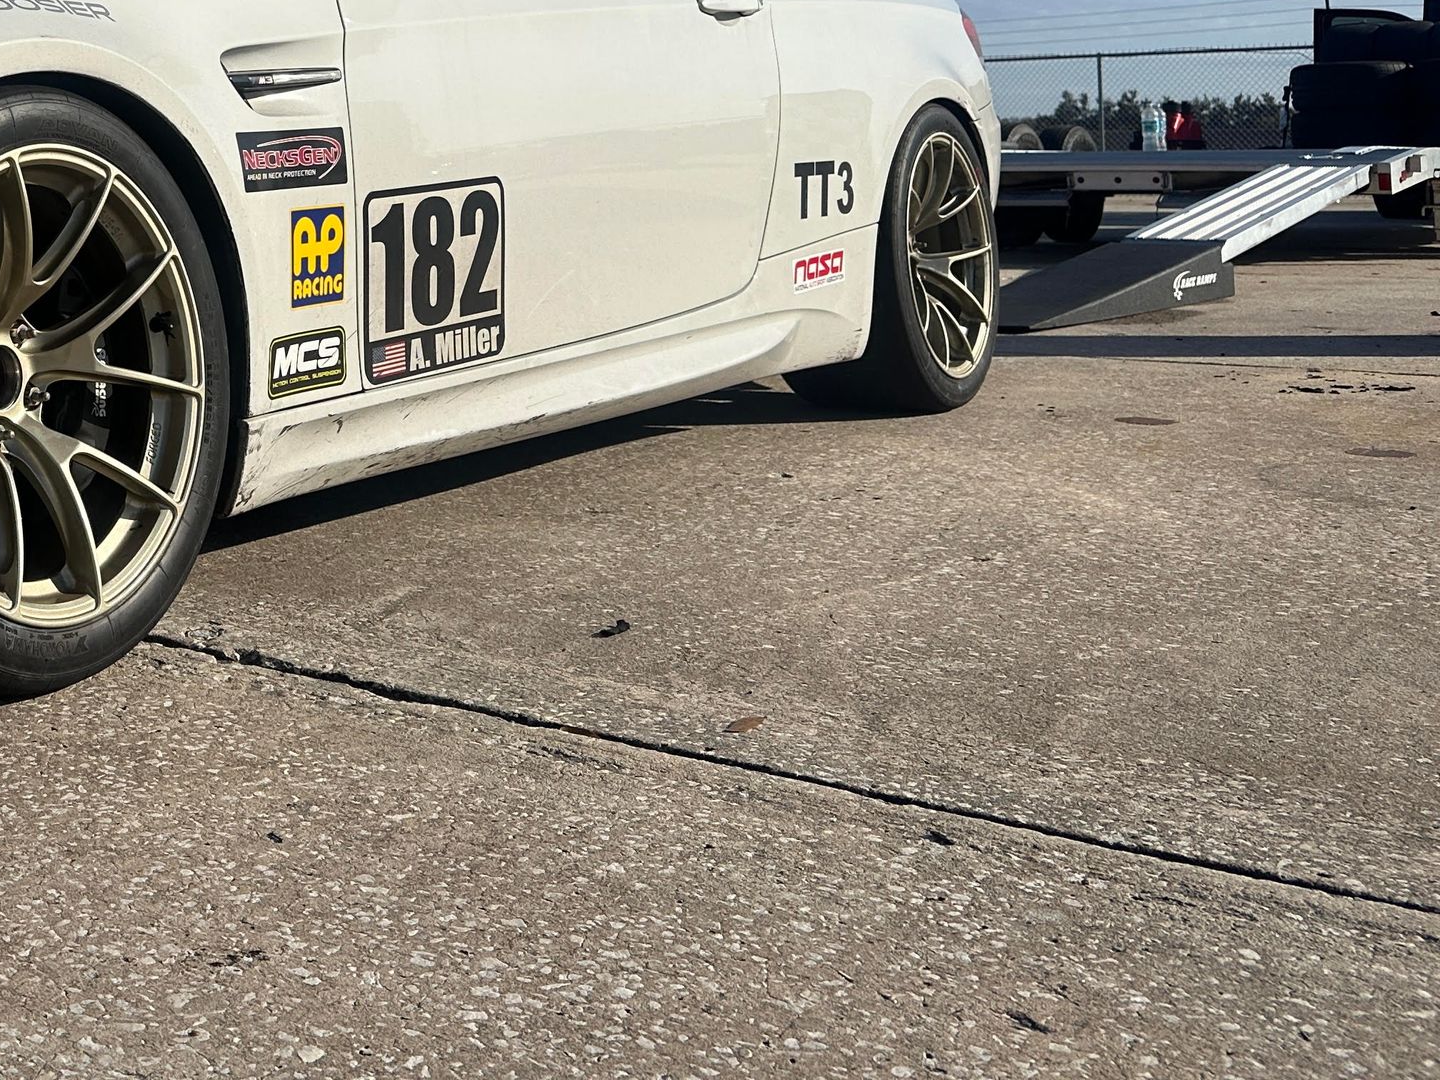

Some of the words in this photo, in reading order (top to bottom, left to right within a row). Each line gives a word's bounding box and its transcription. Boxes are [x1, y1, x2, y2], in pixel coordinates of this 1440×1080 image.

[247, 173, 262, 181] AHEAD
[283, 169, 317, 178] PROTECTION
[794, 160, 854, 219] TT3
[293, 213, 343, 276] AP
[371, 189, 499, 334] 182
[293, 273, 343, 300] RACING
[273, 336, 341, 379] MCS
[409, 337, 431, 372] A.
[434, 325, 500, 365] Miller
[146, 422, 162, 465] FORGED
